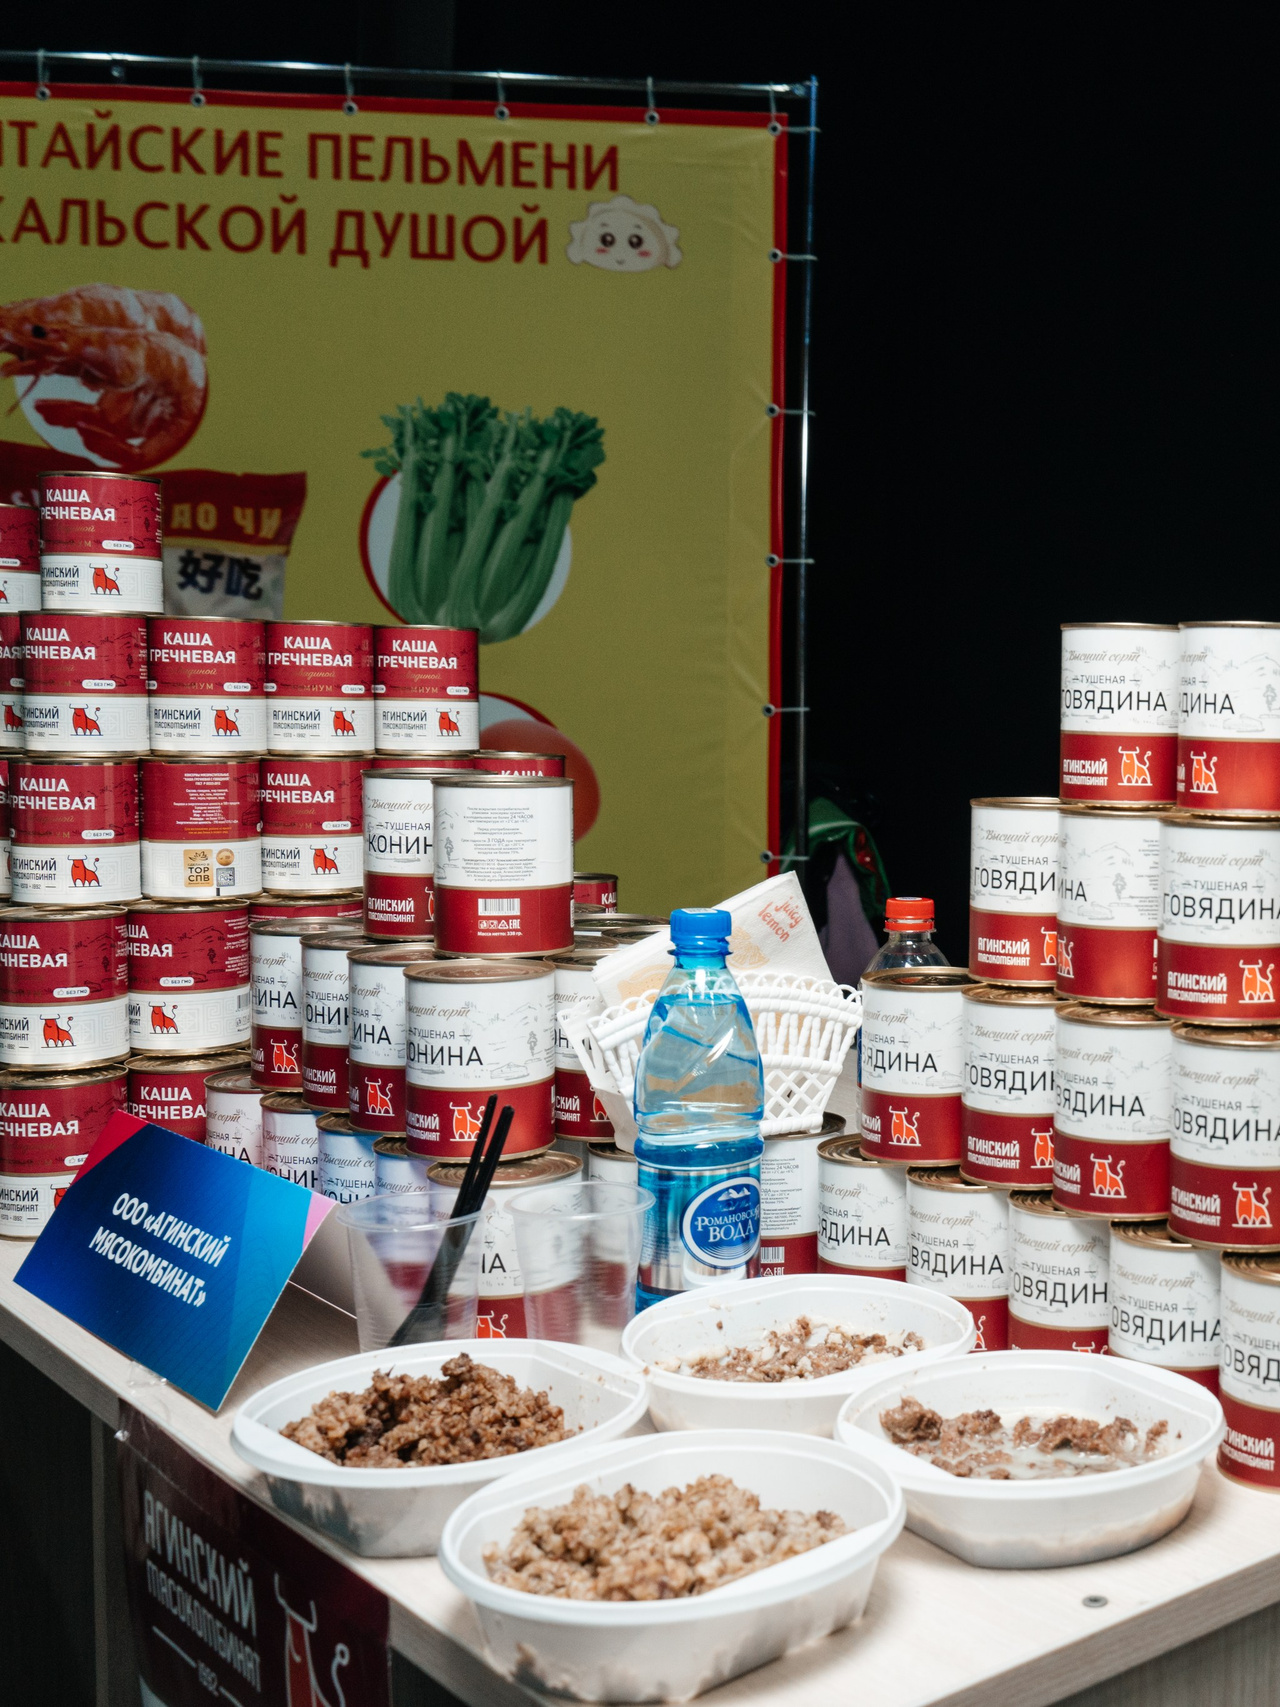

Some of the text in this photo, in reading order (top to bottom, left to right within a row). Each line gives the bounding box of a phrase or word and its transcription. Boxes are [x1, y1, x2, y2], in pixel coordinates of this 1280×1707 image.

[0, 109, 618, 192] ТАЙСКИЕ ПЕЛЬМЕНИ
[0, 193, 548, 269] АЛЬСКОЙ ДУШОЙ
[46, 488, 90, 503] КАША
[41, 506, 116, 522] РЕЧНЕВАЯ
[177, 550, 263, 600] 好吃
[26, 628, 70, 642] КАША
[163, 632, 214, 646] КАША
[284, 636, 332, 650] КАША
[392, 640, 438, 653] КАША
[150, 648, 236, 664] ГРЕЧНЕВАЯ
[268, 652, 353, 667] ГРЕЧНЕВАЯ
[378, 655, 458, 670] ГРЕЧНЕВАЯ
[1081, 675, 1126, 684] ТУШЕНАЯ
[1062, 690, 1168, 714] ГОВЯДИНА
[1180, 692, 1235, 717] ДИНА
[272, 708, 321, 721] АГИНСКИЙ
[382, 710, 428, 722] АГИНСКИЙ
[1063, 758, 1108, 774] АГИНСКИЙ
[20, 777, 70, 792] КАША
[267, 772, 312, 786] КАША
[261, 790, 335, 804] РЕЧНЕВАЯ
[414, 801, 434, 814] сор
[385, 821, 431, 832] ТУШЕНАЯ
[1000, 855, 1048, 866] ТУШЕНАЯ
[1176, 852, 1264, 870] Высший сорт
[974, 866, 1056, 894] ГОВЯДИ
[1194, 880, 1248, 891] ТУШЕНАЯ
[368, 898, 414, 913] АГИНСКИЙ
[775, 896, 802, 928] juicy
[758, 901, 790, 942] lemon
[128, 924, 149, 939] ША
[128, 944, 173, 958] НЕВАЯ
[978, 937, 1030, 955] АГИНСКИЙ
[0, 953, 68, 968] ЧНЕВАЯ
[1167, 972, 1228, 992] АГИНСКИЙ
[437, 1006, 470, 1021] сорт
[354, 1026, 392, 1045] ИНА
[414, 1029, 456, 1040] ТУШЕНАЯ
[990, 1053, 1039, 1064] ТУШЕНАЯ
[964, 1062, 1054, 1095] ГОВЯДИ
[1222, 1072, 1260, 1090] сорт
[140, 1086, 192, 1100] КАША
[0, 1102, 50, 1118] КАША
[556, 1095, 580, 1111] СКИЙ
[1190, 1096, 1242, 1111] ТУШЕНАЯ
[128, 1104, 207, 1120] ГРЕЧНЕВА
[0, 1120, 79, 1138] ЕЧНЕВАЯ
[968, 1136, 1020, 1157] АГИНСКИЙ
[276, 1155, 318, 1164] ТУШЕНАЯ
[336, 1178, 374, 1189] ТУШЕНА
[0, 1188, 39, 1202] ИНСКИЙ
[944, 1212, 974, 1229] сорт
[112, 1192, 232, 1268] ООО «АГИНСКИЙ
[708, 1219, 754, 1242] ВОДА
[1062, 1240, 1096, 1258] сорт
[88, 1226, 206, 1308] МЯСОКОМБИНАТ»
[906, 1244, 1004, 1278] ВЯДИНА
[1030, 1262, 1080, 1277] ТУШЕНАЯ
[1014, 1272, 1108, 1308] ОВЯДИН
[1158, 1274, 1196, 1292] сорт
[1127, 1295, 1178, 1313] ТУШЕНАЯ
[1112, 1305, 1220, 1346] ОВЯДИНА
[1224, 1425, 1275, 1458] ГИНСКИЙ
[144, 1489, 256, 1637] АГИНСКИЙ
